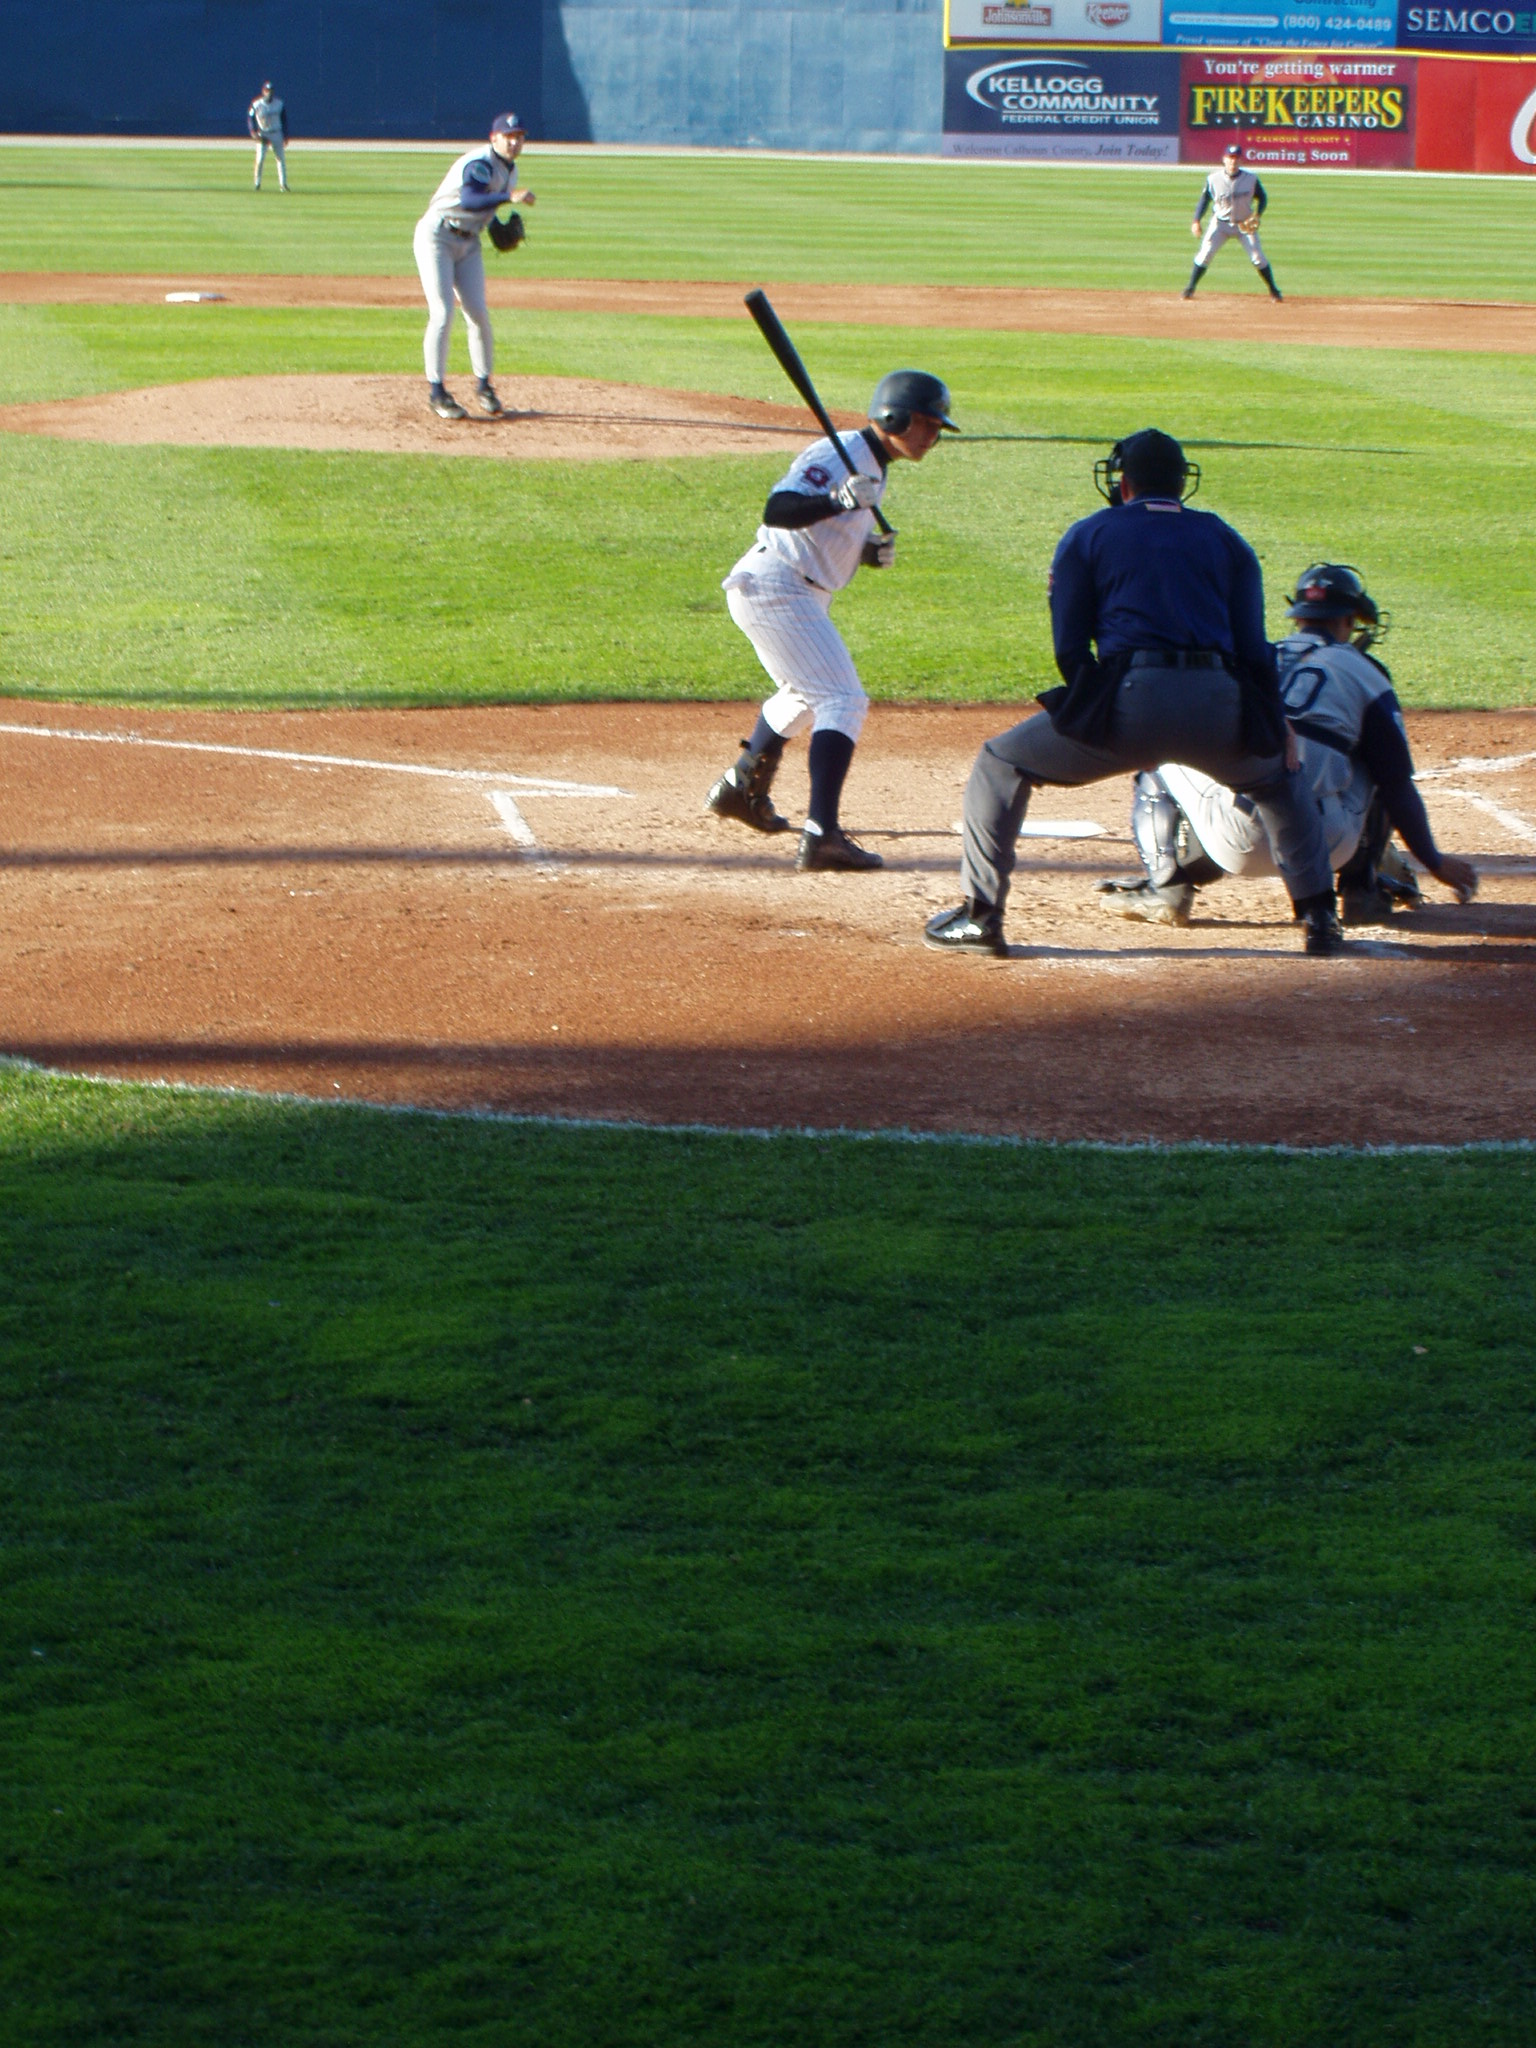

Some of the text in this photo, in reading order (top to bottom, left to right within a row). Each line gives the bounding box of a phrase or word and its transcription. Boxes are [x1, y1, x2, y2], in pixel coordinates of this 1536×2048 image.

[984, 8, 1049, 25] Johnsonville
[1086, 3, 1130, 21] Keebler
[1283, 14, 1320, 31] (800)
[1204, 59, 1396, 78] You're getting warmer
[988, 76, 1104, 93] KELLOGG
[1002, 95, 1159, 111] COMMUNITY
[1191, 84, 1403, 128] FIREKEEPERS
[1002, 114, 1160, 125] FEDERAL CREDIT UNION
[1296, 115, 1379, 128] CASINO
[1255, 136, 1299, 144] CALHOUN
[1095, 144, 1122, 156] Join
[1127, 145, 1170, 158] Today!
[1246, 148, 1348, 163] Coming Soon
